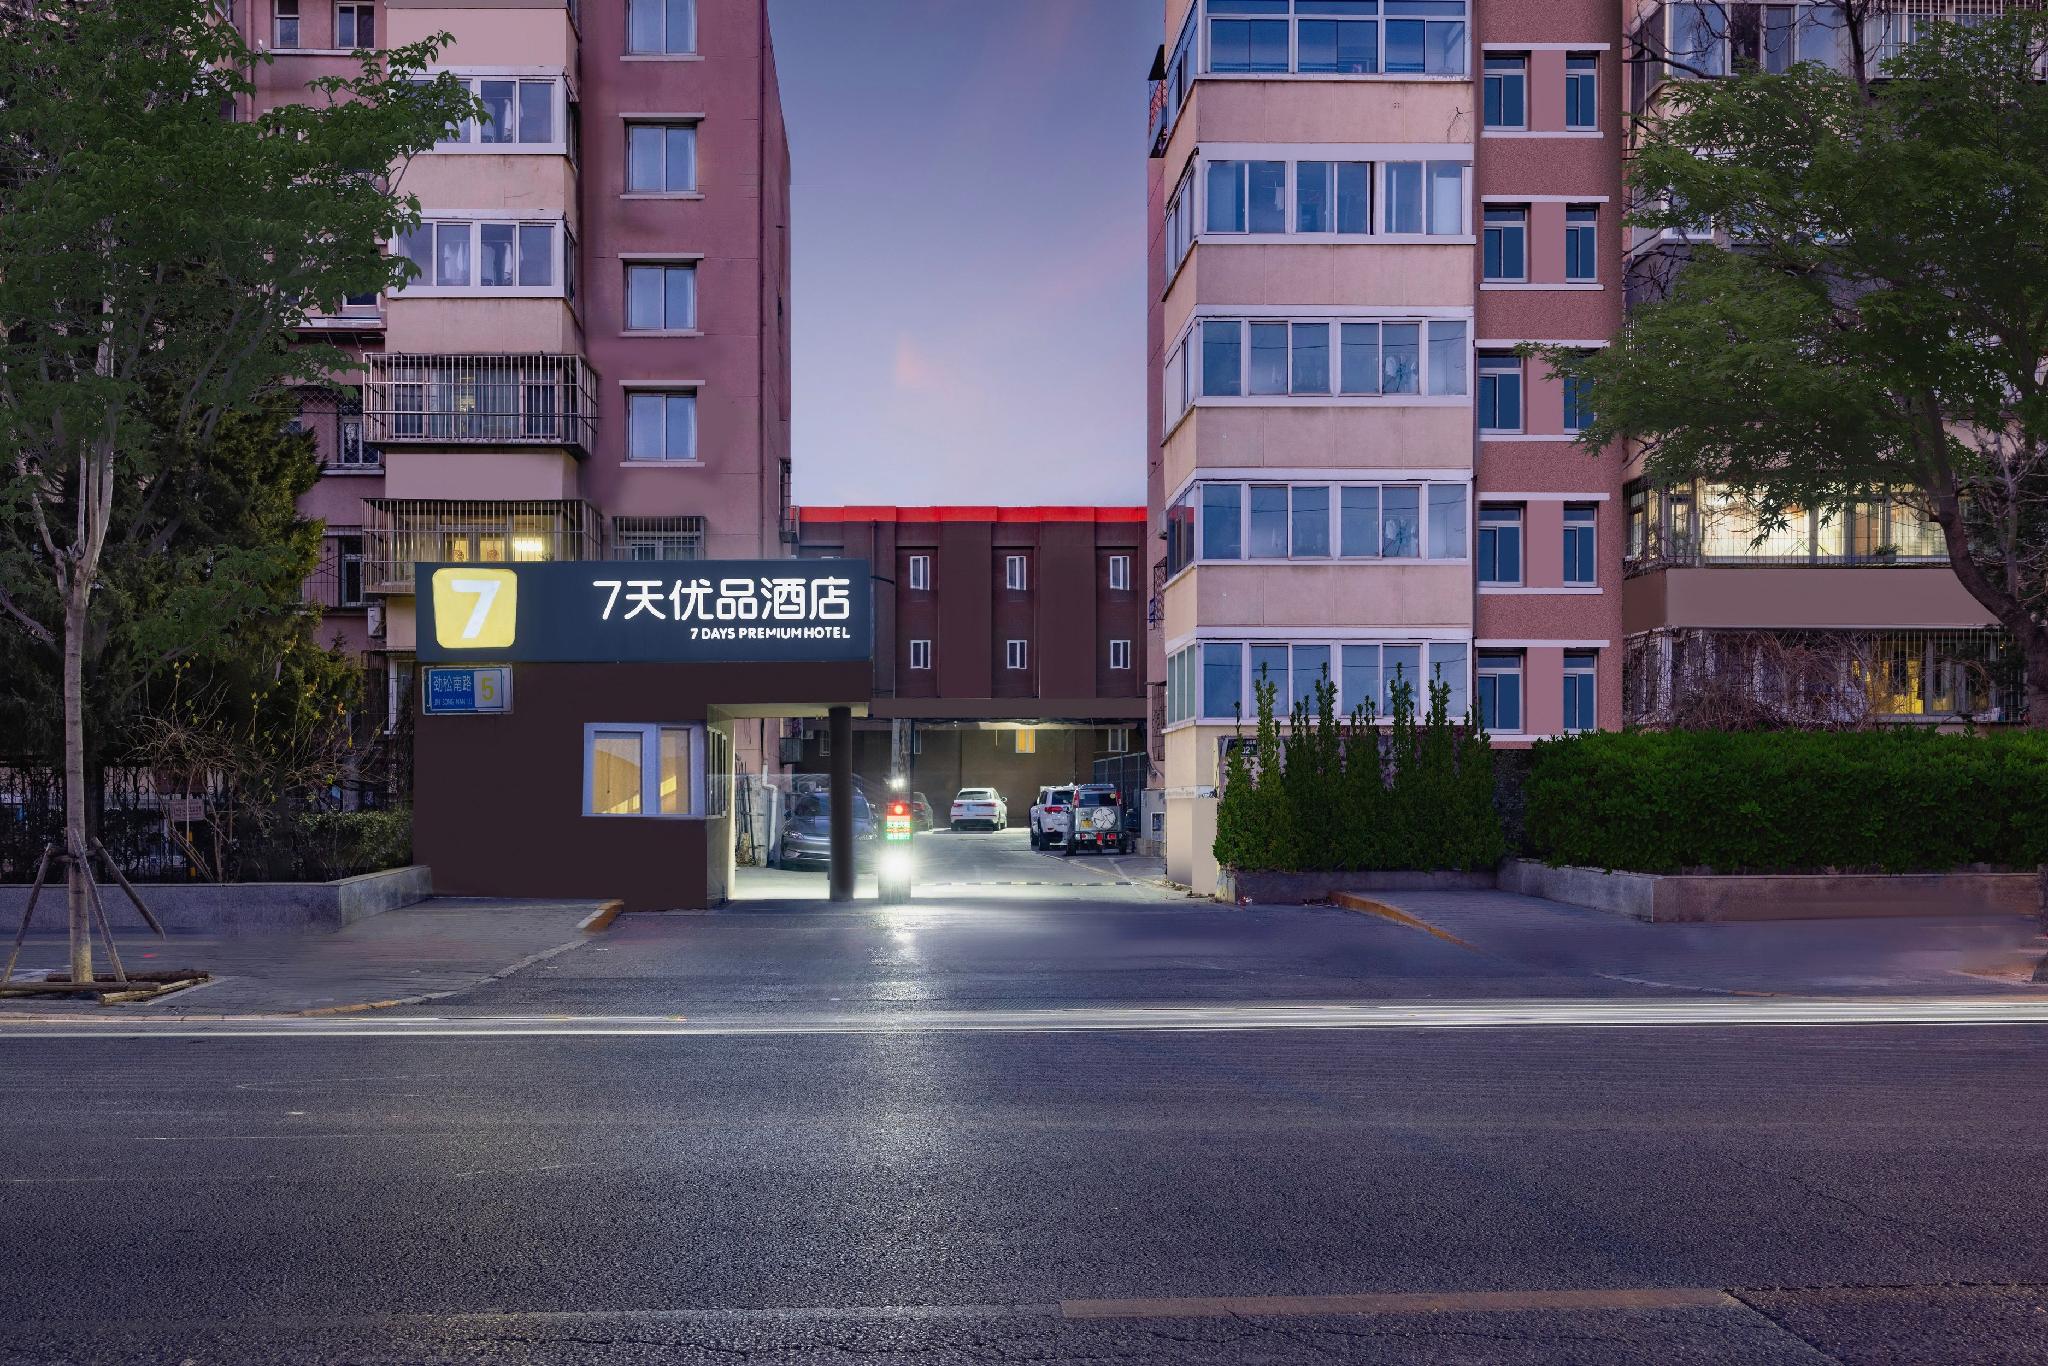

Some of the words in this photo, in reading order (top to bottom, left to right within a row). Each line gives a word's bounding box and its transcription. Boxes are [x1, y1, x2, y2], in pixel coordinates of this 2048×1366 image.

[451, 580, 500, 639] 7
[593, 576, 850, 620] 7天优品酒店
[690, 627, 699, 639] 7
[701, 627, 735, 639] DAYS
[738, 627, 802, 639] PREMIUM
[803, 626, 850, 639] HOTEL
[482, 677, 495, 701] 5
